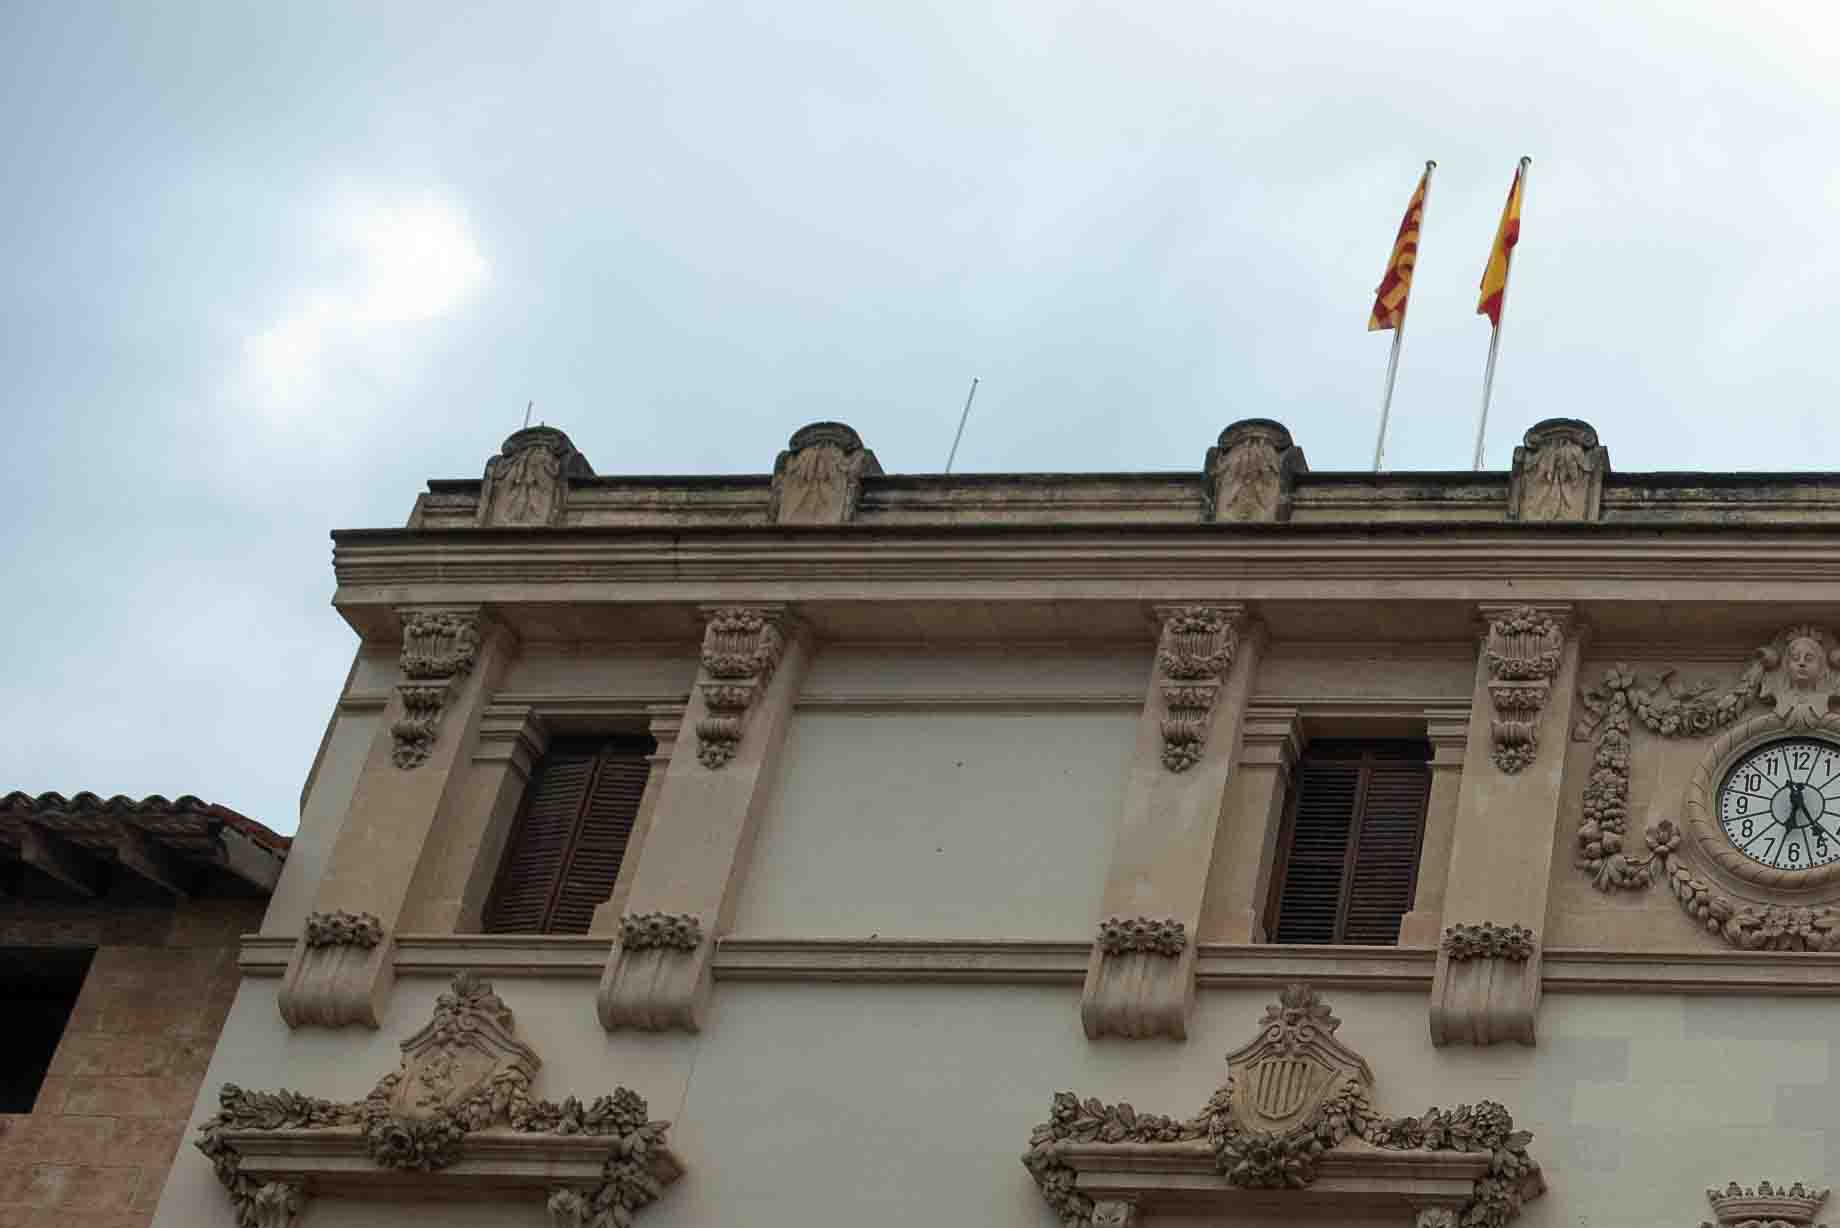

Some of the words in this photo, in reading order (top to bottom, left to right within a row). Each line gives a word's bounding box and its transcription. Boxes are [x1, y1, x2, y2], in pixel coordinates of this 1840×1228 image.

[1766, 758, 1778, 776] 11
[1792, 752, 1809, 770] 12
[1824, 758, 1830, 776] 1
[1744, 774, 1761, 792] 10
[1736, 796, 1748, 814] 9
[1741, 819, 1753, 837] 8
[1763, 838, 1775, 857] 7
[1788, 843, 1799, 861] 6
[1816, 838, 1828, 857] 5
